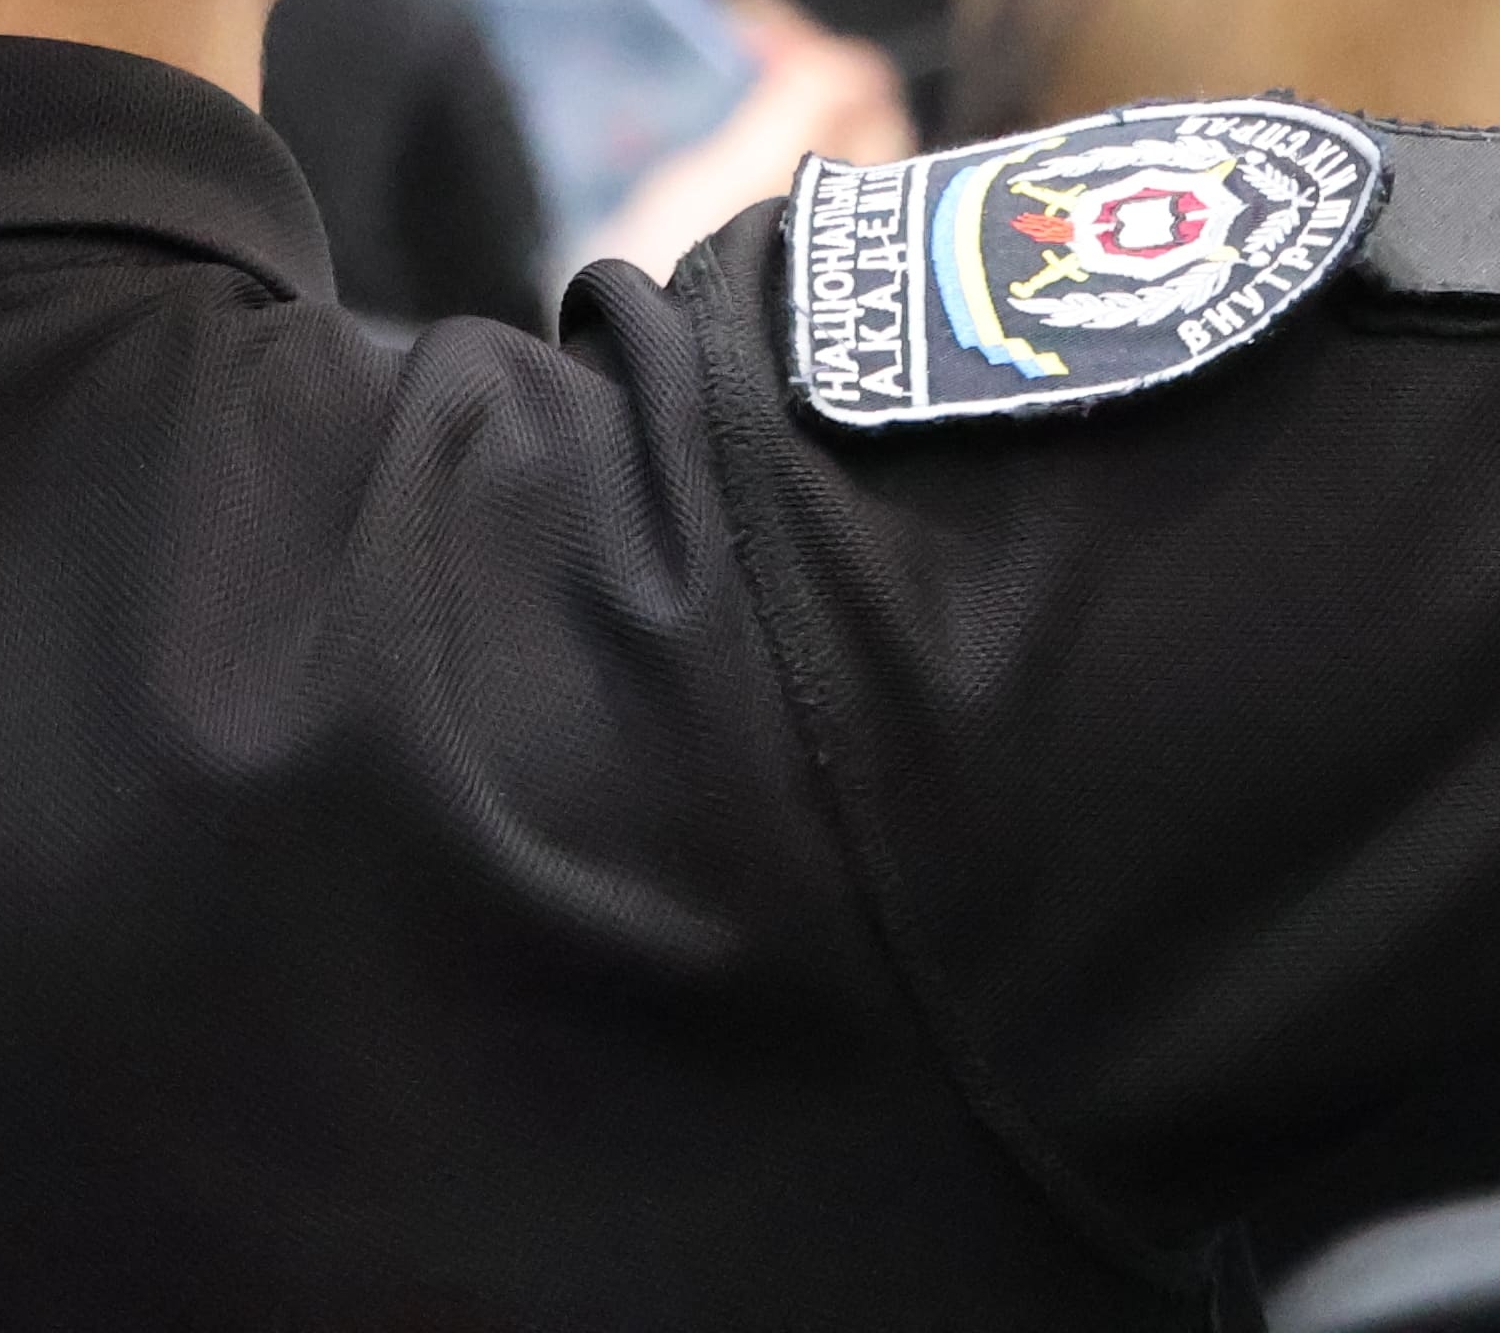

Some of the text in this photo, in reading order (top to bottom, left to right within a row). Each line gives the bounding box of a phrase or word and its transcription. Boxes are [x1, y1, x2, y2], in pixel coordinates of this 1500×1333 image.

[811, 172, 864, 401] НАЦІОНАЛЬН
[1175, 116, 1358, 357] ВНУТРІШНІХ СПРАВ
